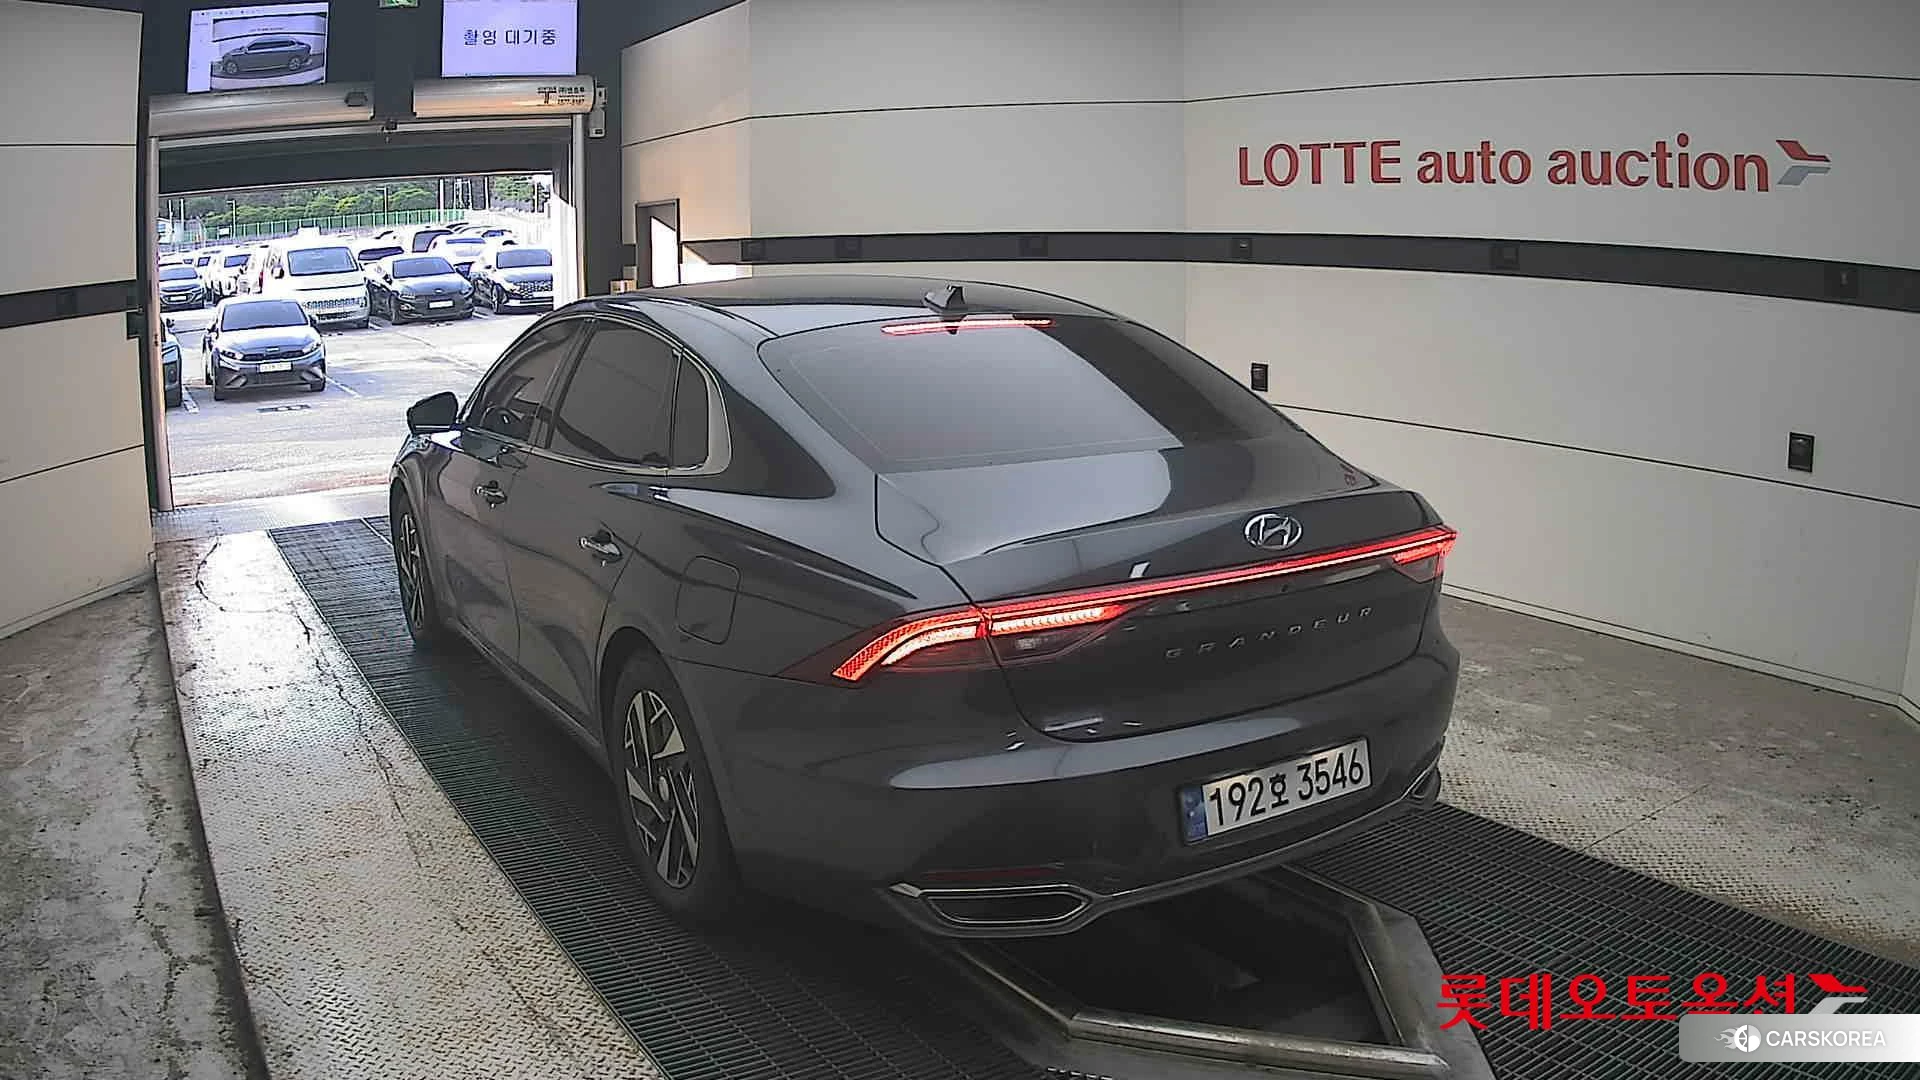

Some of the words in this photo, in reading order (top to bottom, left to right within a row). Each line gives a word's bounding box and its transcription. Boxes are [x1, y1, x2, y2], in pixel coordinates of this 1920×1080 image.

[505, 29, 556, 46] 대기중
[1239, 140, 1400, 186] LOTTE
[1417, 141, 1532, 185] auto
[1547, 134, 1769, 191] auction
[1166, 607, 1373, 658] GRANDEUR
[1209, 771, 1289, 826] 192호
[1297, 747, 1364, 800] 3546
